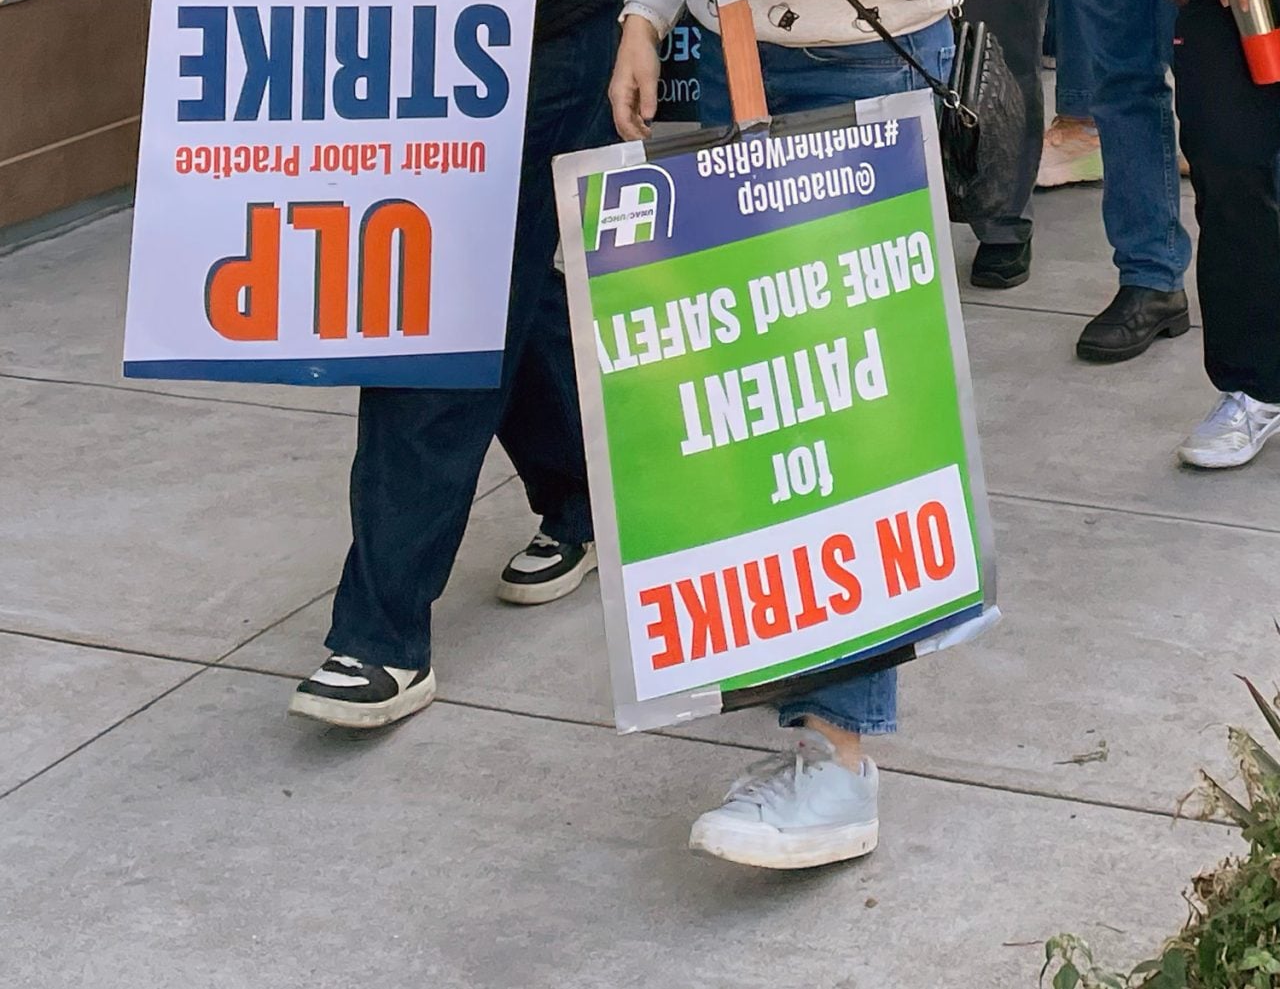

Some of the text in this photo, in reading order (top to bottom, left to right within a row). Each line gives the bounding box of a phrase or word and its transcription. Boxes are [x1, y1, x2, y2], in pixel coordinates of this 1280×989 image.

[177, 3, 512, 122] STRIKE
[175, 141, 486, 180] Unfair Labor Practice
[697, 118, 900, 179] #TogetherWeRise
[737, 162, 876, 215] @unacuhcp
[204, 197, 432, 342] ULP
[748, 260, 832, 335] and
[837, 230, 935, 308] CARE
[678, 327, 889, 457] PATIENT
[771, 439, 834, 504] for
[639, 500, 956, 671] ON STRIKE
